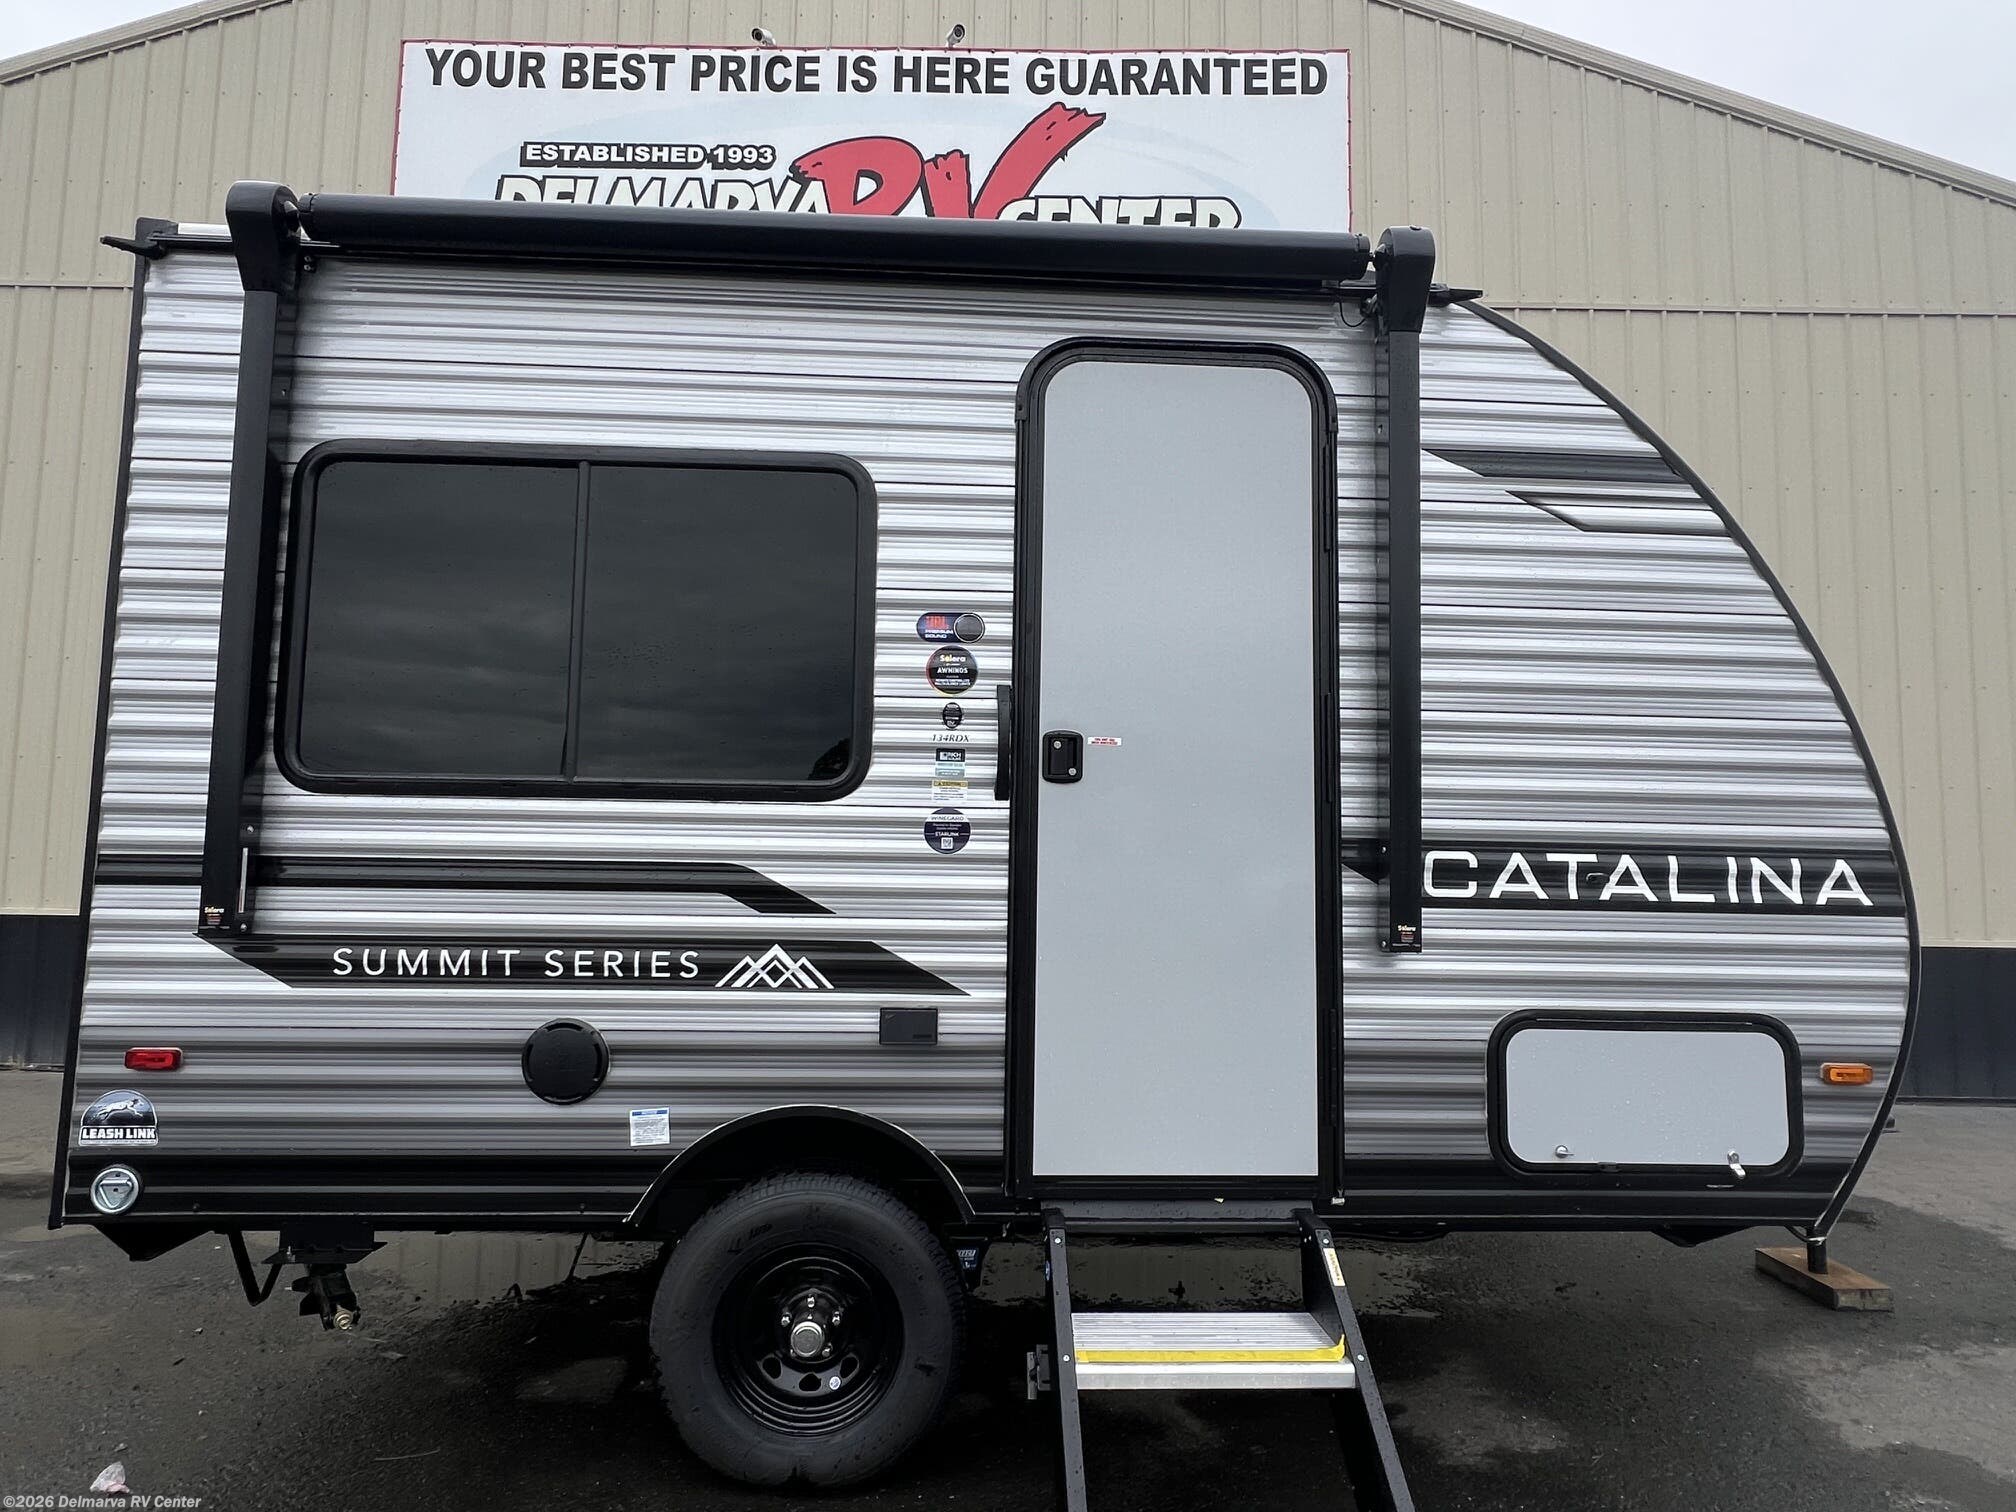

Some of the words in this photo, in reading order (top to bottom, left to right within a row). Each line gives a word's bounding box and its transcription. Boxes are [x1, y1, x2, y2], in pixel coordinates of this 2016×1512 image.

[425, 48, 547, 90] YOUR
[561, 52, 675, 91] BEST
[690, 54, 820, 93] PRICE
[837, 55, 877, 94] IS
[893, 56, 1010, 94] HERE
[1025, 57, 1328, 96] GUARANTEED
[524, 143, 706, 165] ESTABLISHED
[712, 147, 775, 165] 1993
[940, 654, 966, 662] Solera
[932, 733, 970, 743] 134RDX
[1423, 850, 1874, 906] CATALINA
[332, 947, 521, 977] SUMMIT
[544, 949, 699, 979] SERIES
[82, 1128, 124, 1139] LEASH
[125, 1128, 156, 1139] LINK
